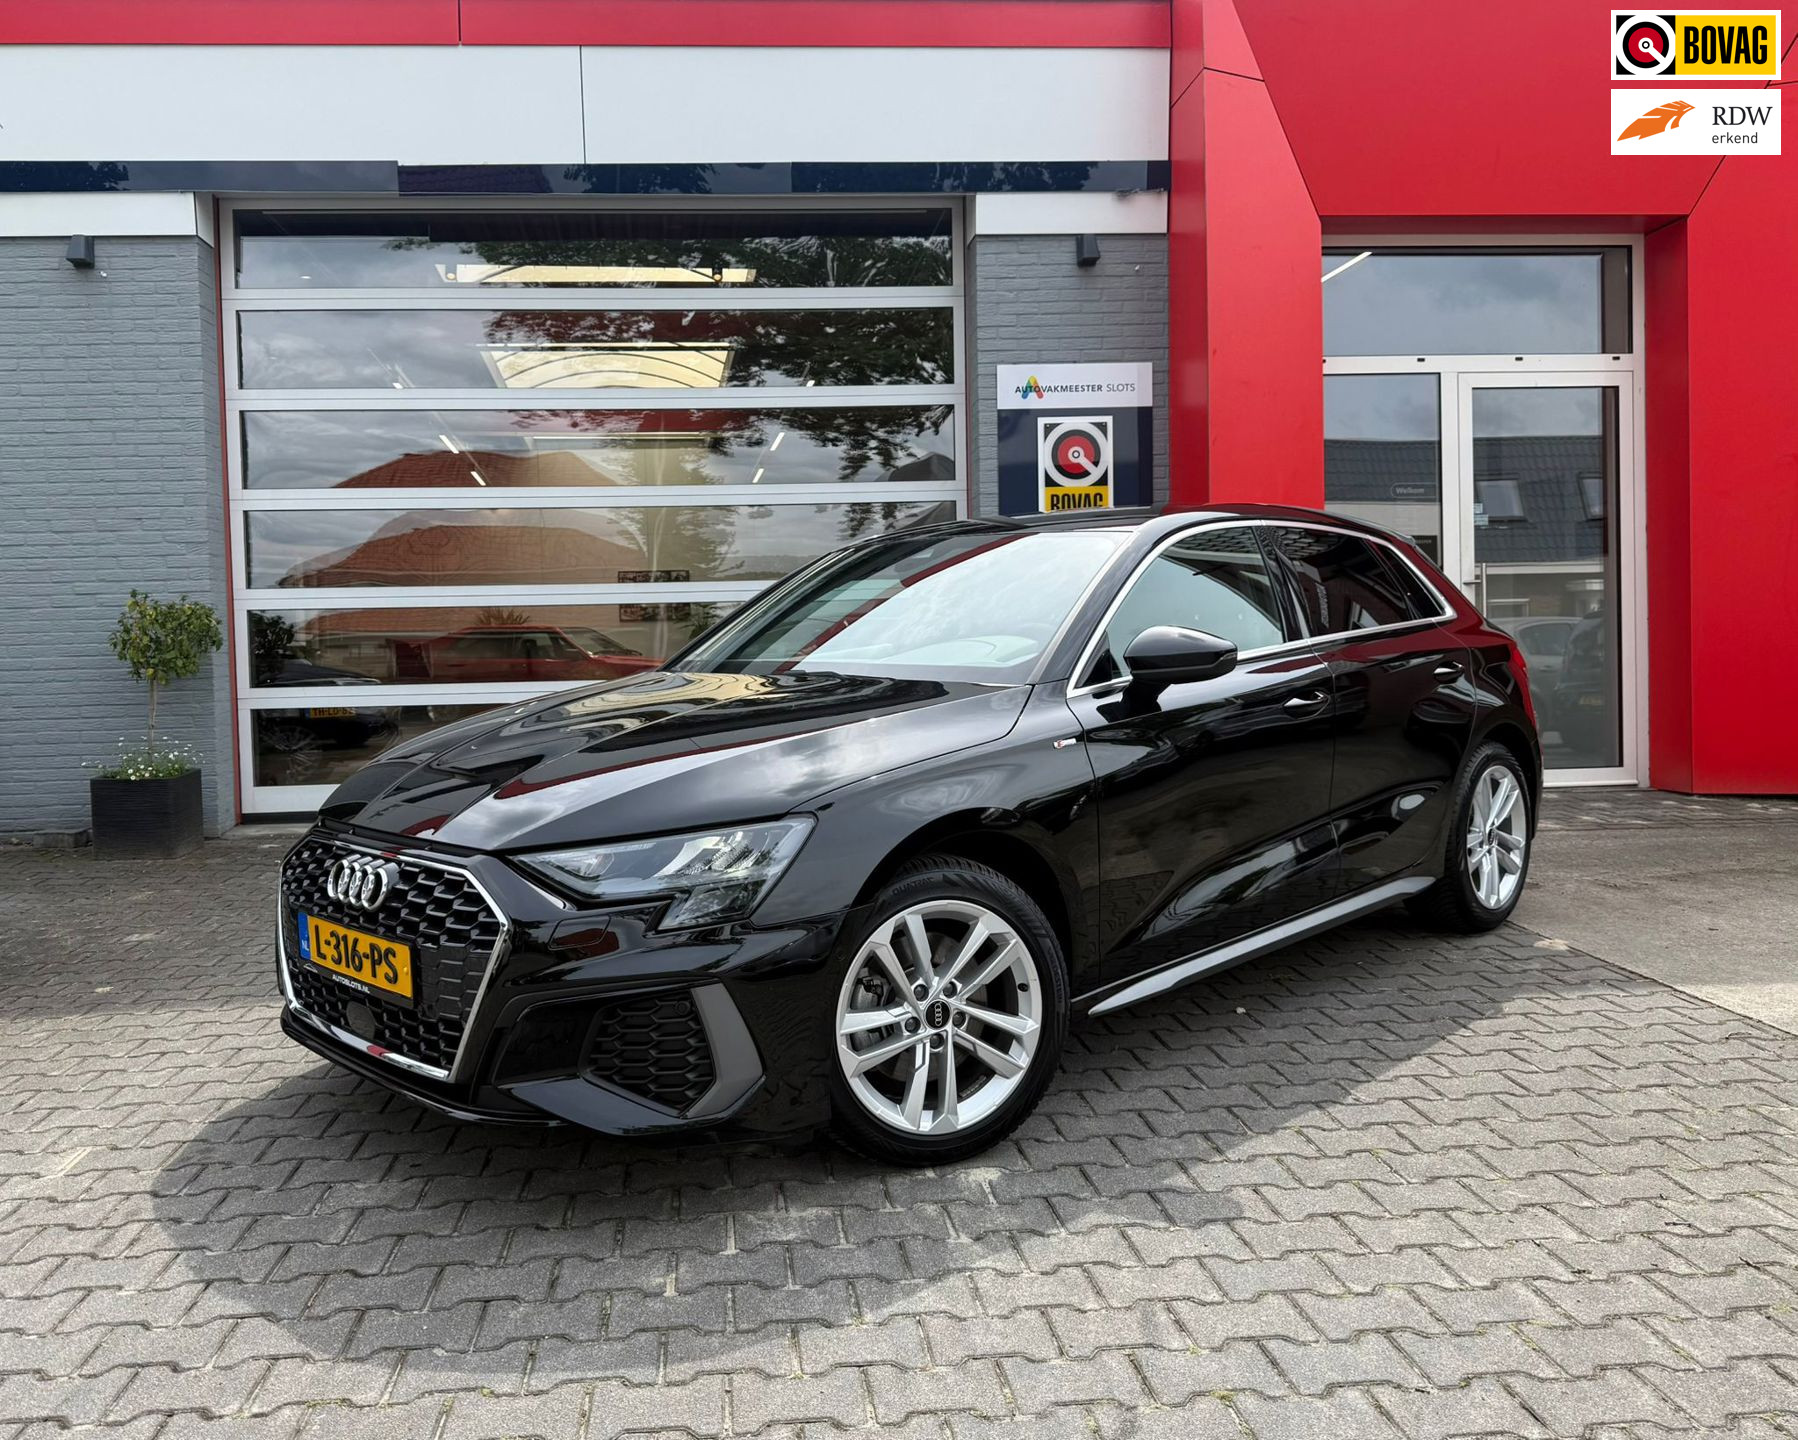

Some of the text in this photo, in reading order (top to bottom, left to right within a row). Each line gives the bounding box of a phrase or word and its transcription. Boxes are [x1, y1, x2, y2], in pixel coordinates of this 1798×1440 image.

[1015, 383, 1136, 394] AUTOVAKMEESTER SLOTS
[301, 939, 310, 951] NL
[314, 924, 399, 985] L-316-PS
